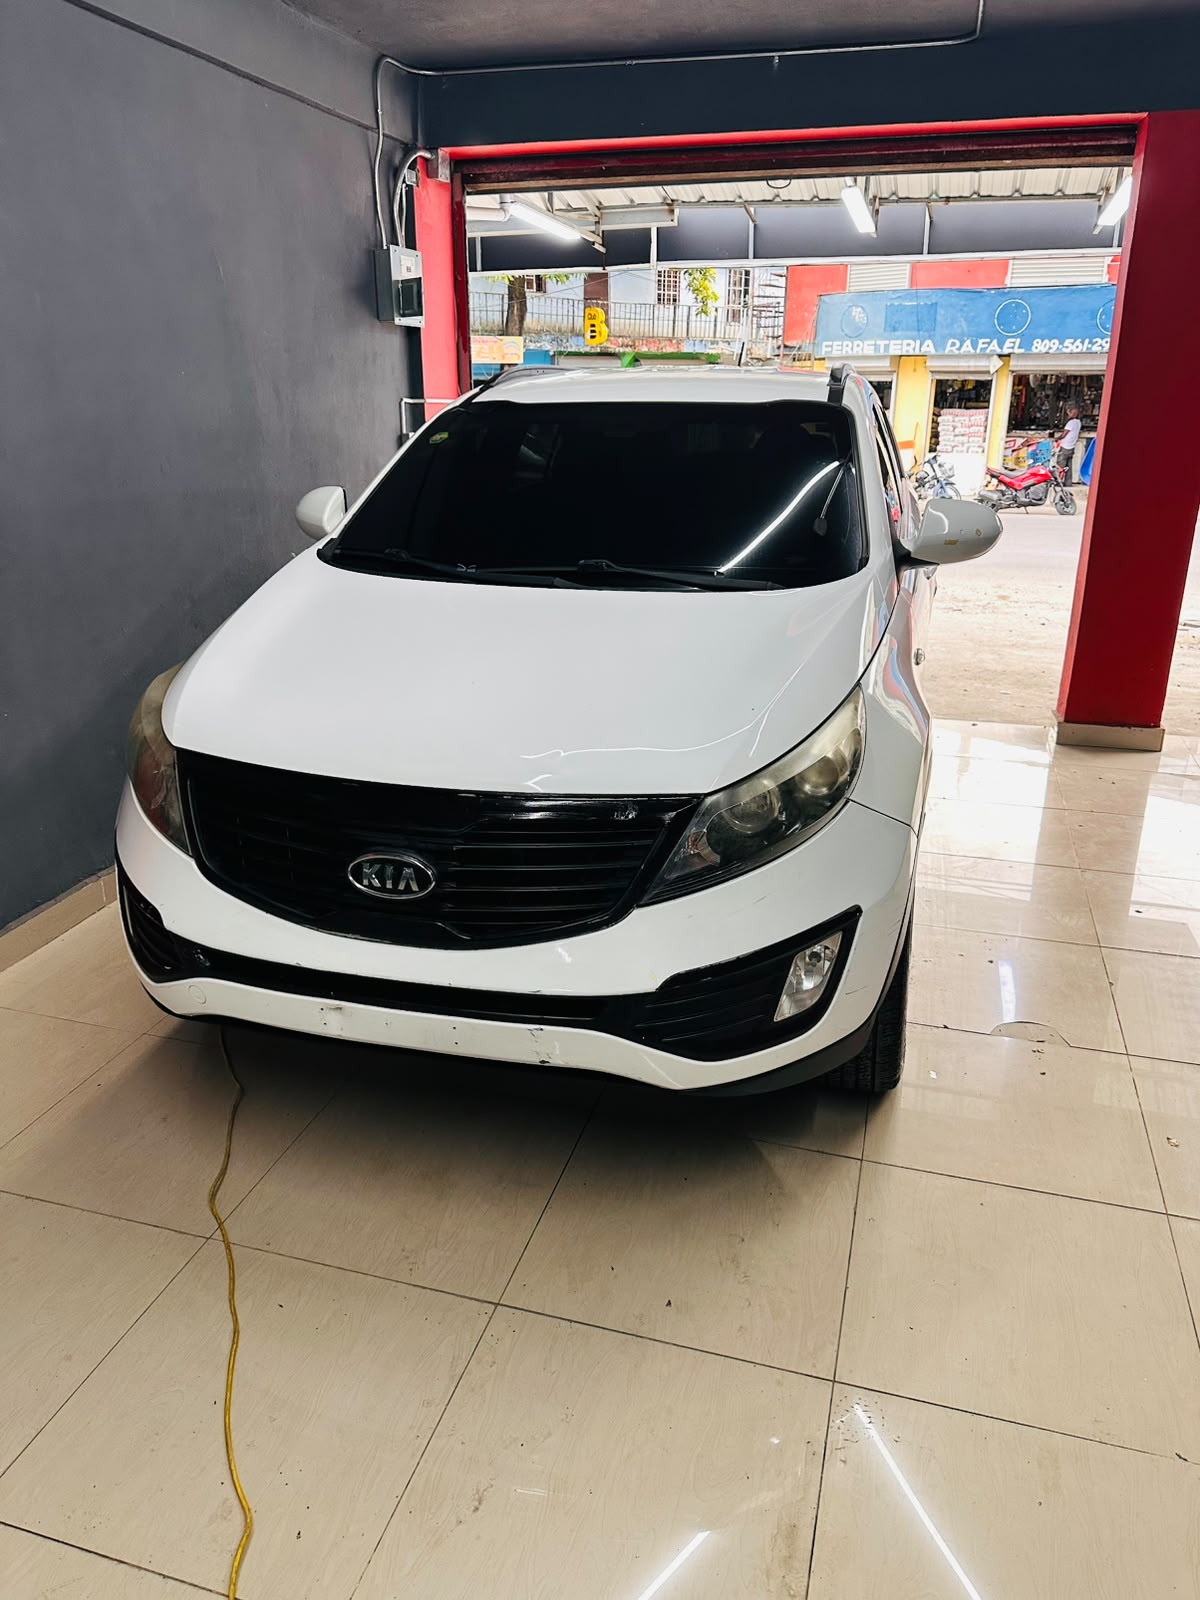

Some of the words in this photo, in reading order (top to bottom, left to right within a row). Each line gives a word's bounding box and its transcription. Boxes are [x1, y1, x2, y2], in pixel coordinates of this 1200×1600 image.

[821, 339, 935, 355] FERRETERIA
[944, 338, 1025, 354] RAFAEL
[361, 862, 420, 892] KIA
